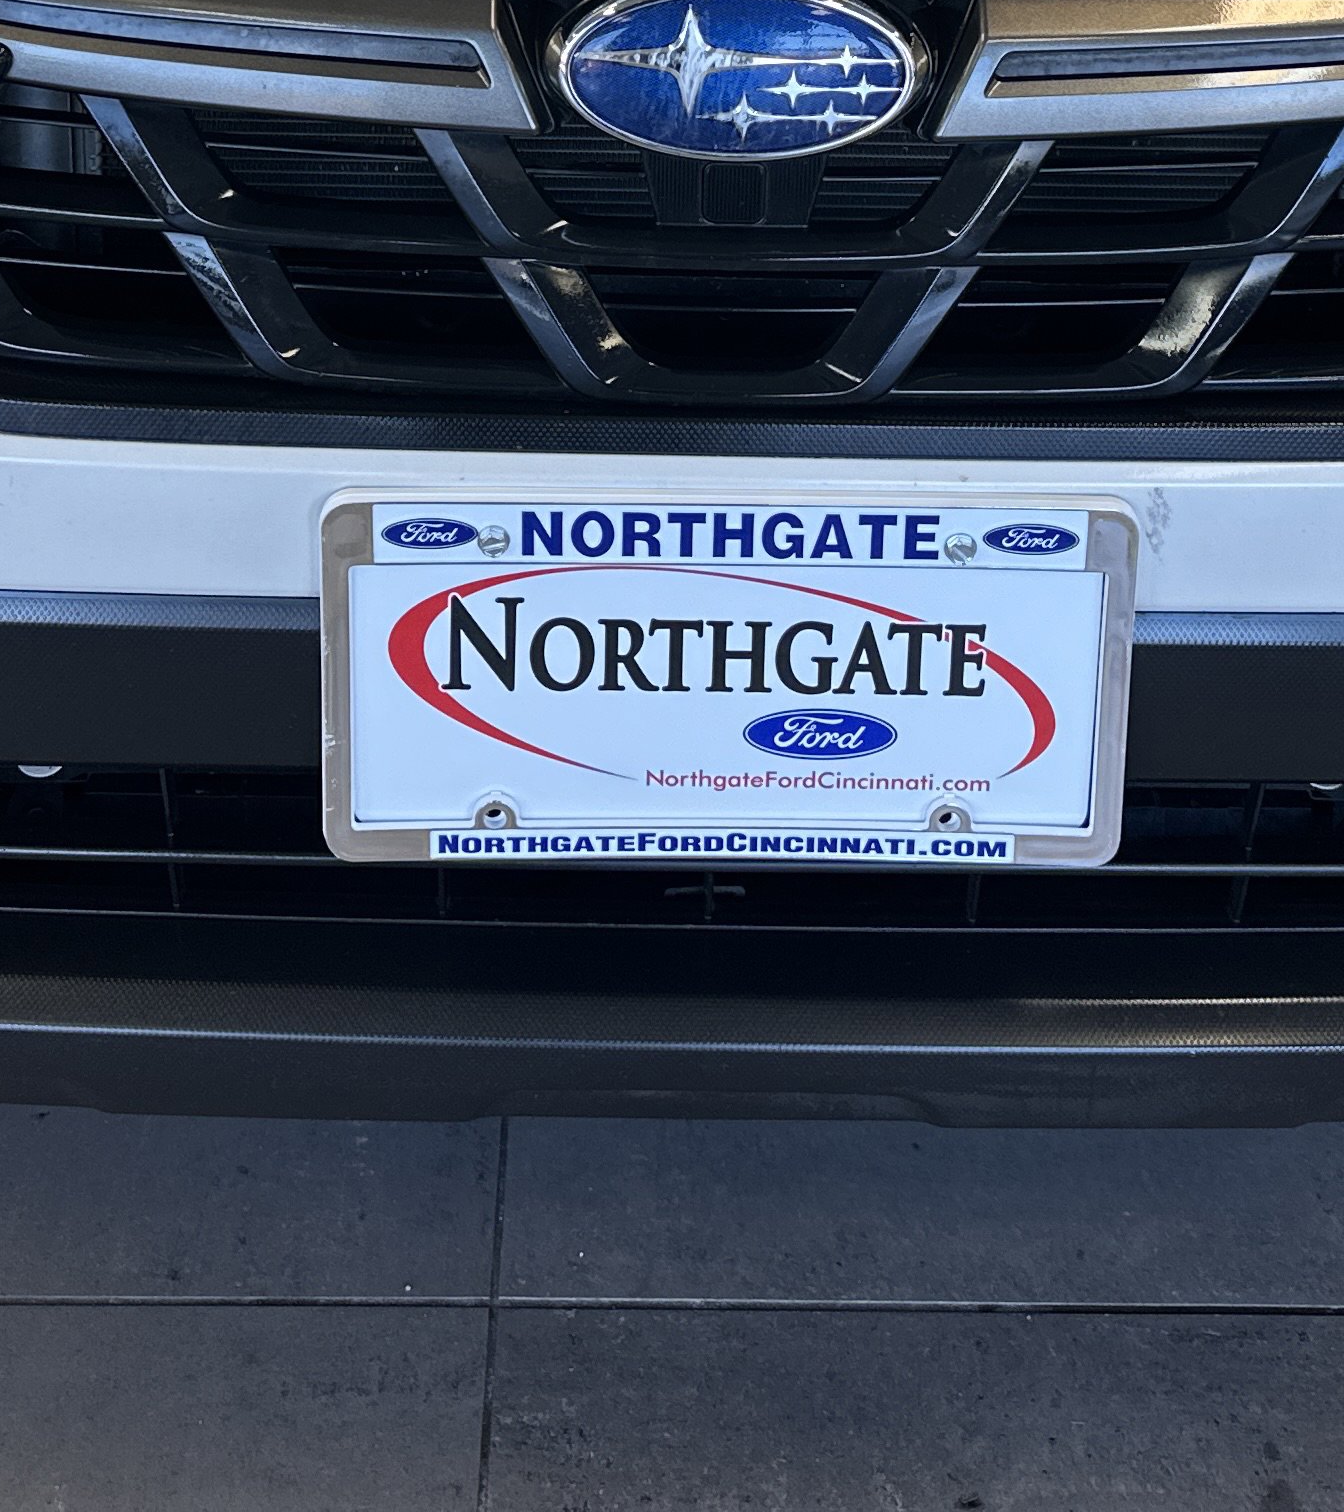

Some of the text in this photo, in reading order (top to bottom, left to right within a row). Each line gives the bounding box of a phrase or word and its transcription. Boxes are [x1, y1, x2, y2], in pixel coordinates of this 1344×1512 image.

[401, 523, 458, 544] Ford
[521, 510, 940, 560] NORTHGATE
[1001, 528, 1060, 550] Ford
[441, 594, 987, 696] NORTHGATE
[773, 716, 866, 749] Ford
[645, 769, 990, 792] NorthgateFordCincinnati.com
